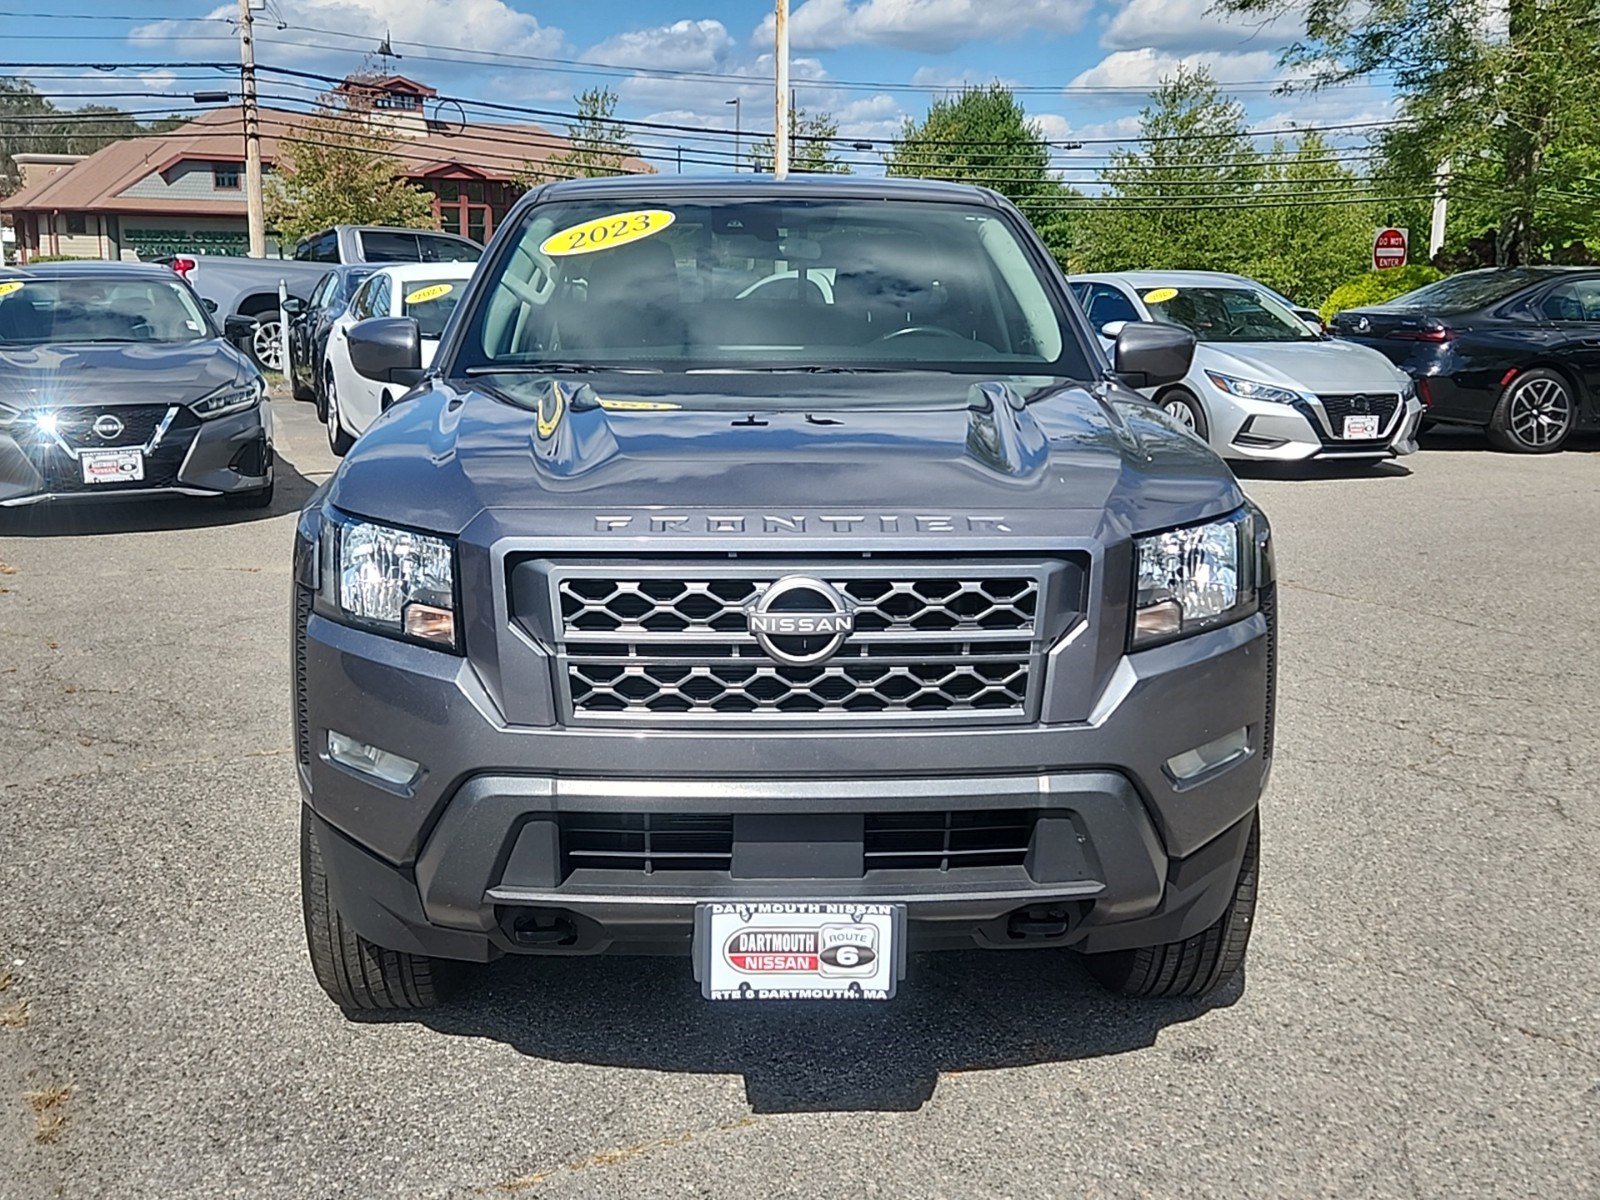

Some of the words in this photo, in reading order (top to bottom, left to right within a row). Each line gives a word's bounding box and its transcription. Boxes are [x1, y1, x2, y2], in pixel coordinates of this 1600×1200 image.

[124, 229, 191, 243] BRISTOL
[568, 214, 652, 251] 2023
[1378, 237, 1388, 246] DO
[1390, 237, 1403, 246] NOT
[1379, 258, 1399, 267] ENTER
[594, 514, 1012, 533] FRONTIER
[750, 615, 853, 633] NISSAN
[712, 903, 820, 914] DARTMOUTH
[826, 903, 891, 915] NISSAN
[739, 933, 815, 952] DARTMOUTH
[828, 933, 868, 943] ROUTE
[745, 956, 810, 970] NISSAN
[835, 946, 859, 966] 6
[711, 990, 742, 1000] RTE
[744, 990, 755, 999] 6
[863, 990, 887, 999] MA
